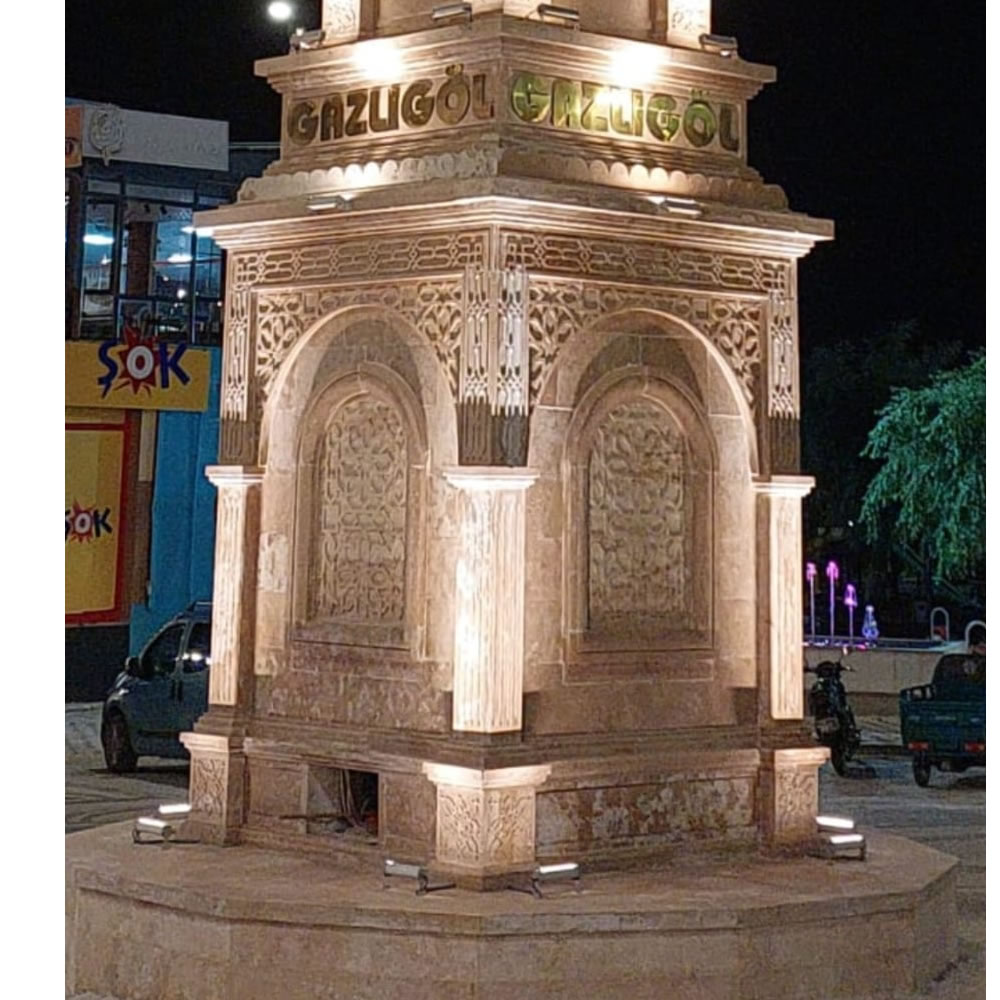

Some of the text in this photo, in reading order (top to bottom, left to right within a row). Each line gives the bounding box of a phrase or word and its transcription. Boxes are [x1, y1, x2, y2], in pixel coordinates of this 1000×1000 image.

[287, 63, 494, 146] GAZLIGÖL
[511, 72, 740, 151] GAZLIGÖL
[97, 337, 190, 399] ŞOK
